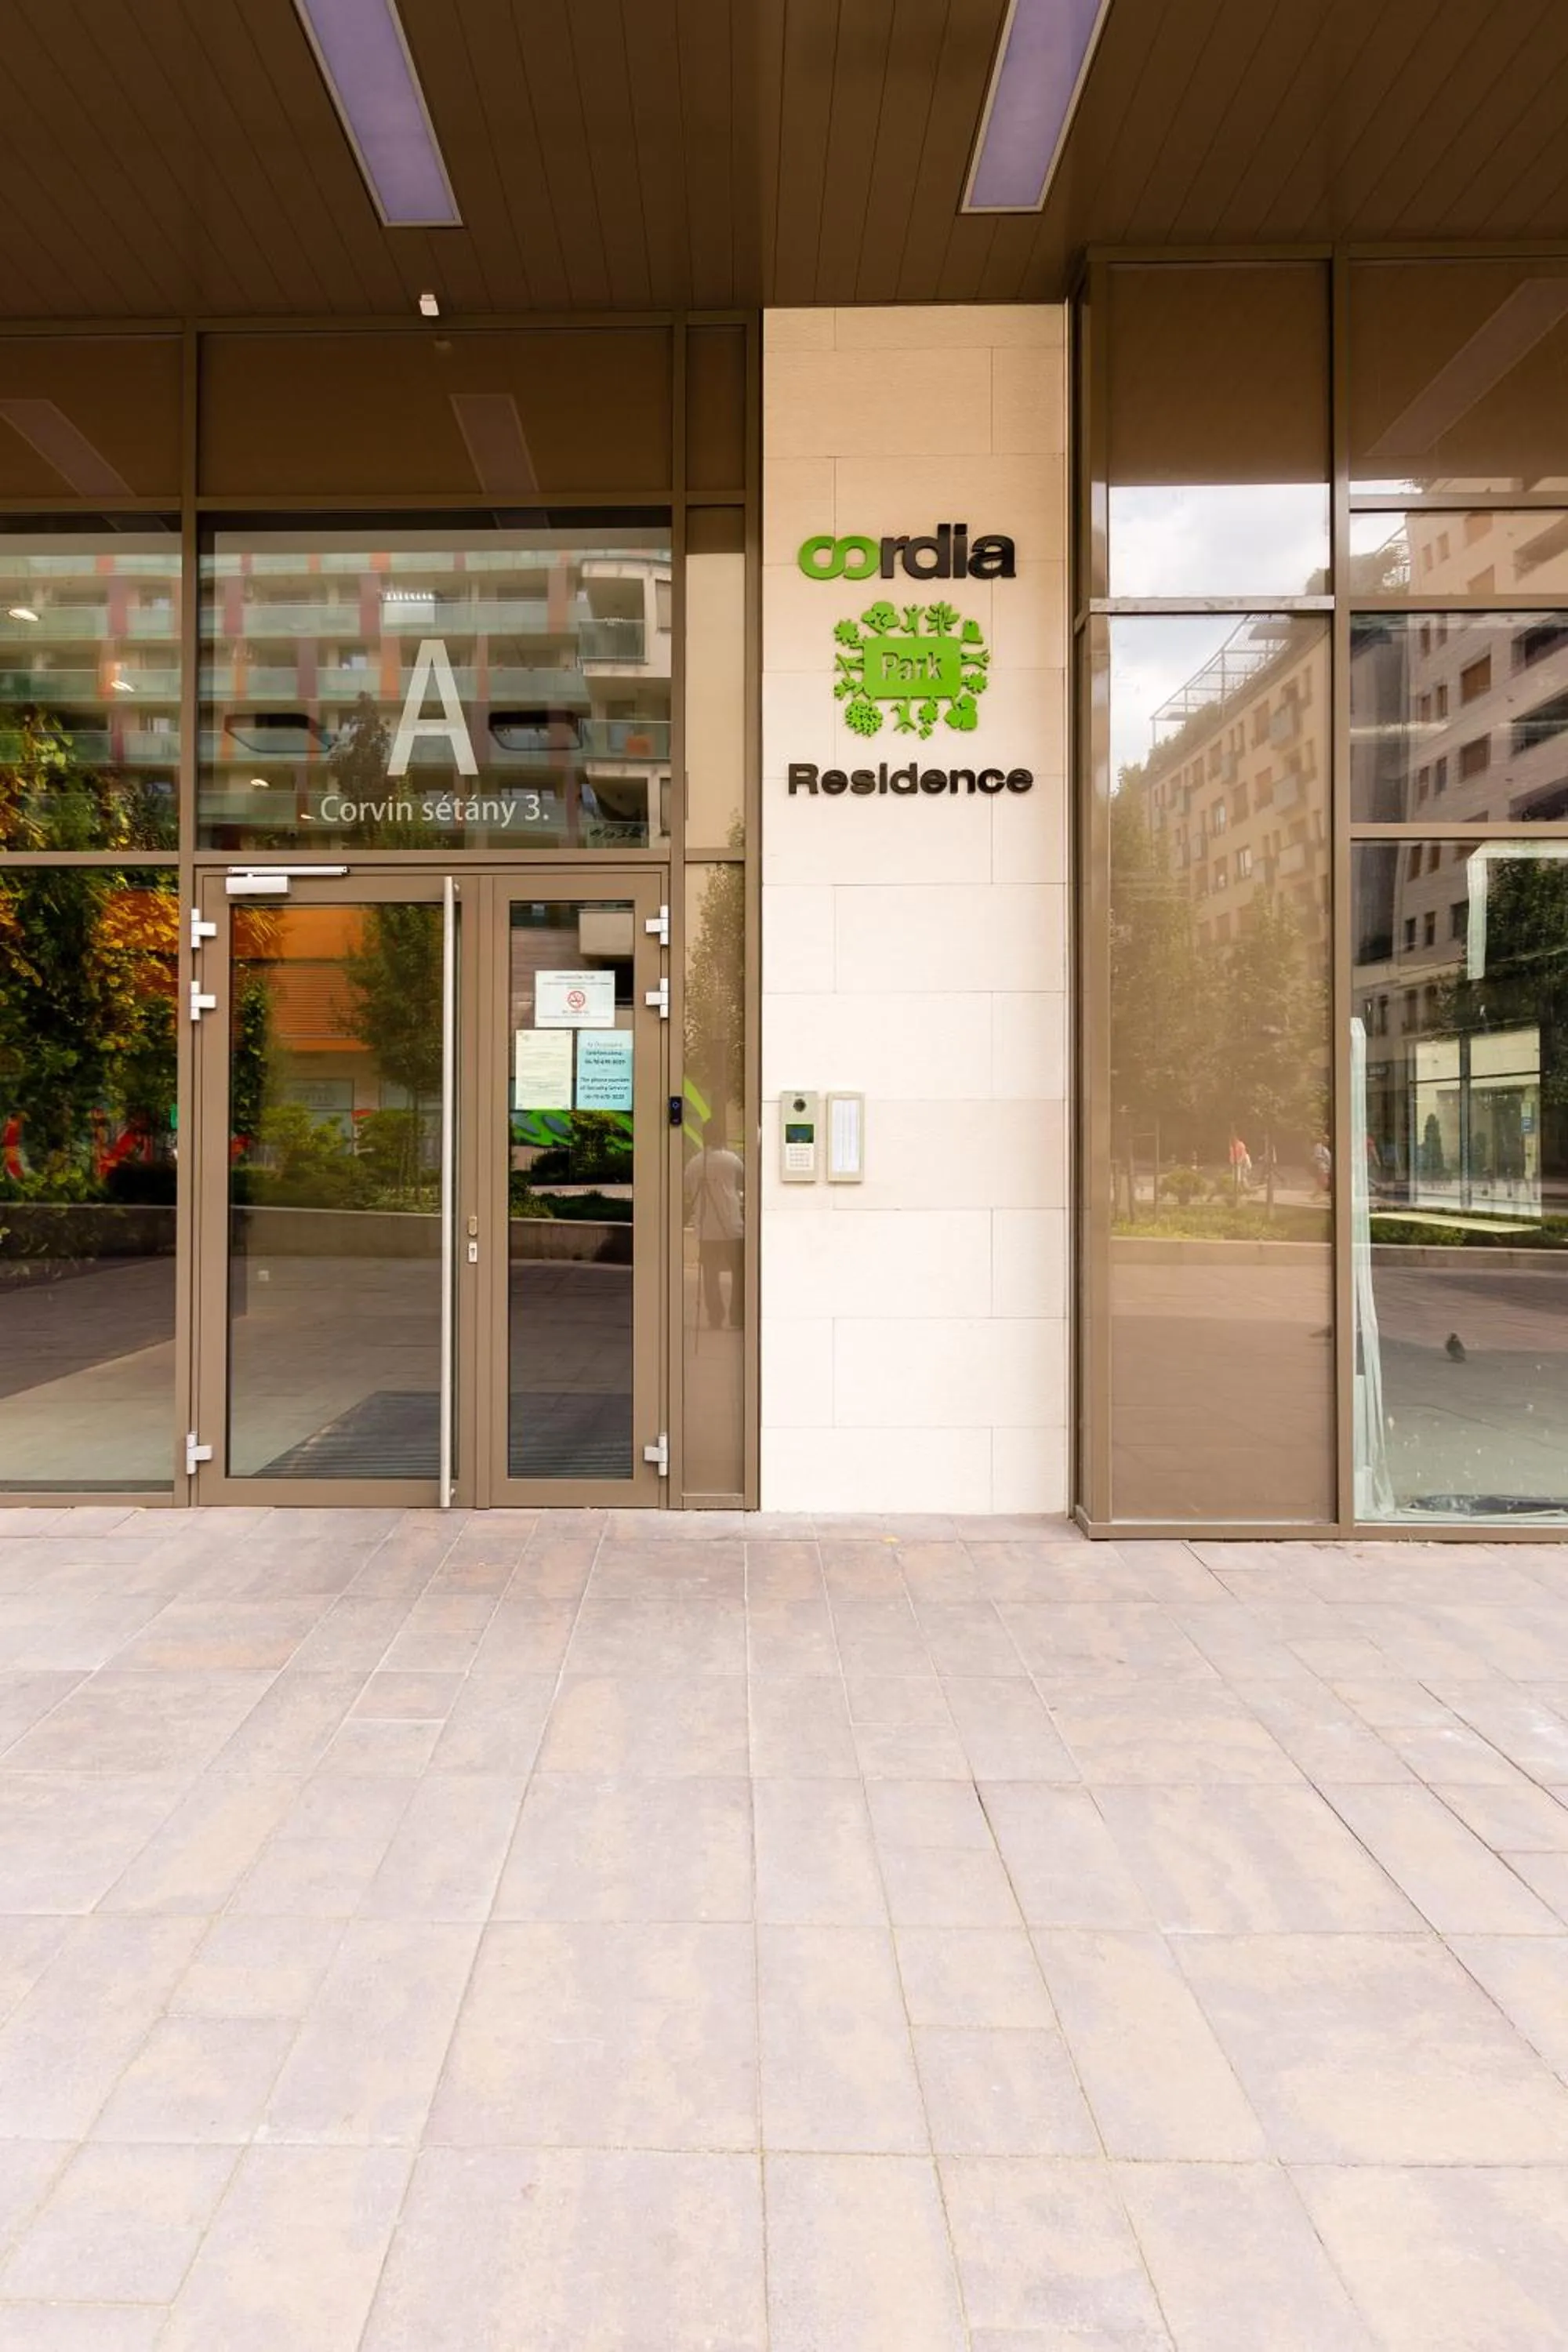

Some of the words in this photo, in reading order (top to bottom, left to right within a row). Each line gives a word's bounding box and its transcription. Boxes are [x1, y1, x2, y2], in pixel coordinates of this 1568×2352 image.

[798, 524, 1016, 579] cordia
[880, 651, 942, 681] Park
[387, 639, 479, 775] A
[788, 762, 1033, 795] Residence
[320, 795, 413, 822] Corvin
[421, 795, 517, 827] sétány
[524, 793, 550, 821] 3.
